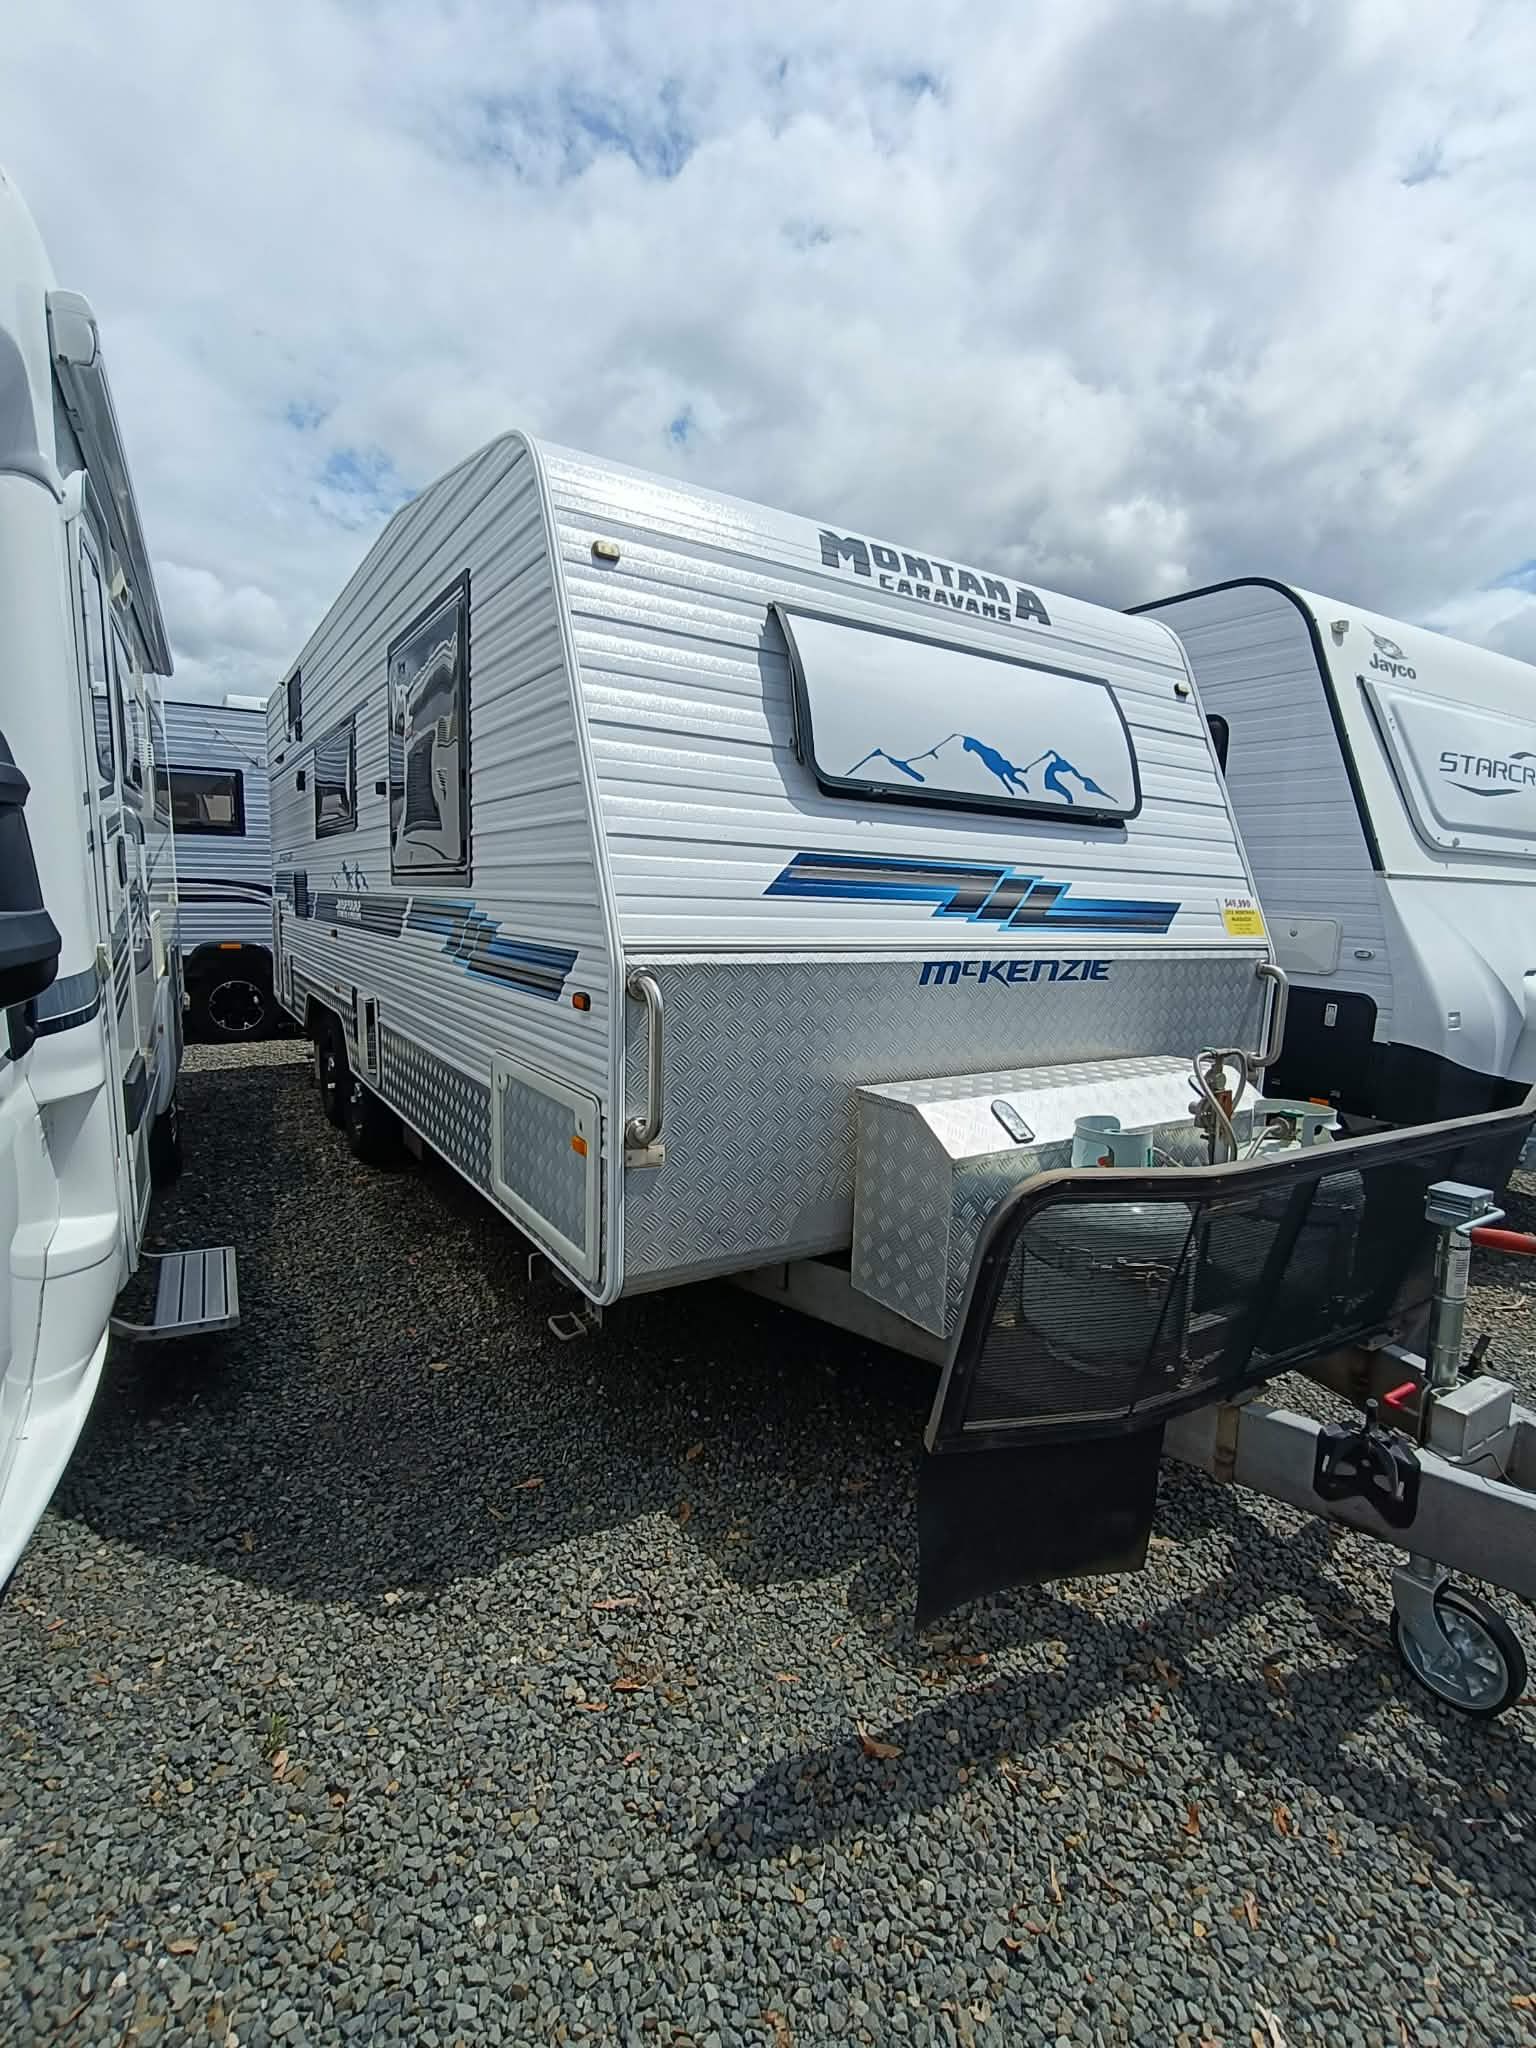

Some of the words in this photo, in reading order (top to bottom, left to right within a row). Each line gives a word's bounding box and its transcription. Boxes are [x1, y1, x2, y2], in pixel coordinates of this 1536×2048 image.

[817, 528, 1052, 626] MONTANA
[879, 573, 1011, 622] CARAVANS
[1369, 652, 1417, 680] Jayco
